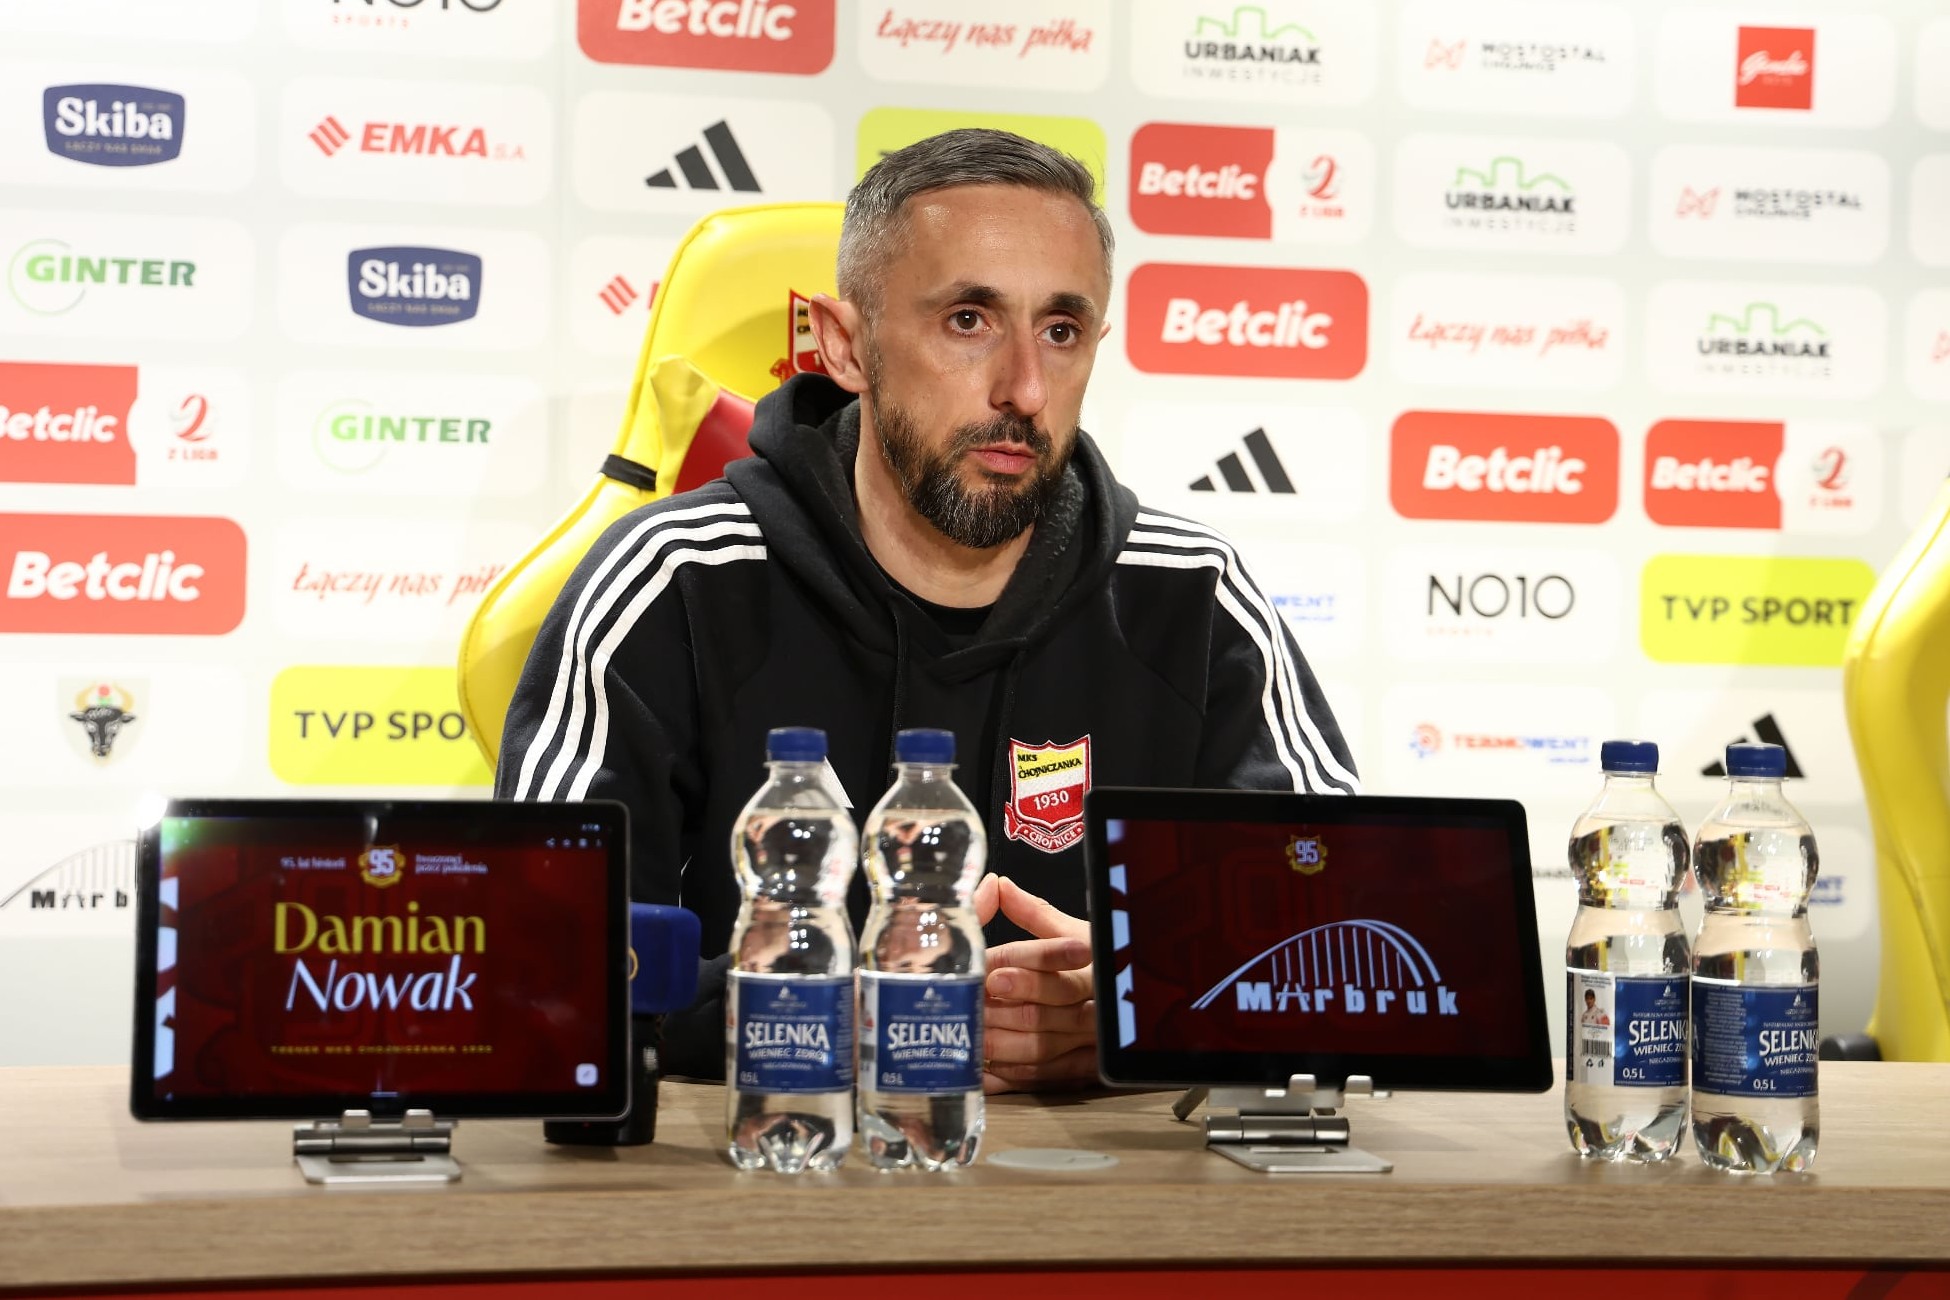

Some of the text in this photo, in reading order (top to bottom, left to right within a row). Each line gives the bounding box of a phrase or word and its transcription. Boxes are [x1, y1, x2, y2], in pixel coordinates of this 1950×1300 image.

[616, 0, 797, 41] Betclic
[876, 8, 1094, 60] Łączy nas piłka
[1185, 40, 1321, 64] URBANIAK
[55, 97, 173, 141] Skiba
[361, 122, 488, 158] EMKA
[1138, 161, 1259, 201] Betclic
[1445, 190, 1576, 213] URBANIAK
[25, 253, 197, 288] GINTER
[358, 259, 471, 301] Skiba
[1161, 298, 1333, 349] Betclic
[1697, 337, 1830, 358] URBANIAK
[330, 412, 493, 445] GINTER
[1422, 444, 1587, 494] Betclic
[1650, 455, 1770, 492] Betclic
[6, 549, 205, 602] Betclic
[292, 561, 506, 606] Łączy nas pił
[1427, 573, 1576, 620] NO10
[1661, 595, 1856, 627] TVP SPORT
[294, 710, 467, 741] TVP SPO
[1017, 753, 1038, 763] MKS
[1018, 757, 1082, 780] CHOJNICZANKA
[1033, 790, 1070, 811] 1930
[1028, 830, 1077, 850] CHOJNICE
[1295, 840, 1319, 864] 95
[369, 848, 396, 876] 95
[274, 900, 486, 955] Damian
[284, 953, 478, 1012] Nowak
[745, 1021, 831, 1052] SELENKA
[887, 1021, 972, 1051] SELENKA
[1628, 1020, 1690, 1047] SELENK
[748, 1047, 792, 1060] WIENIEC
[892, 1047, 937, 1061] WIENIEC
[1633, 1043, 1674, 1057] WIENIEC
[1764, 1052, 1805, 1067] WIENIEC
